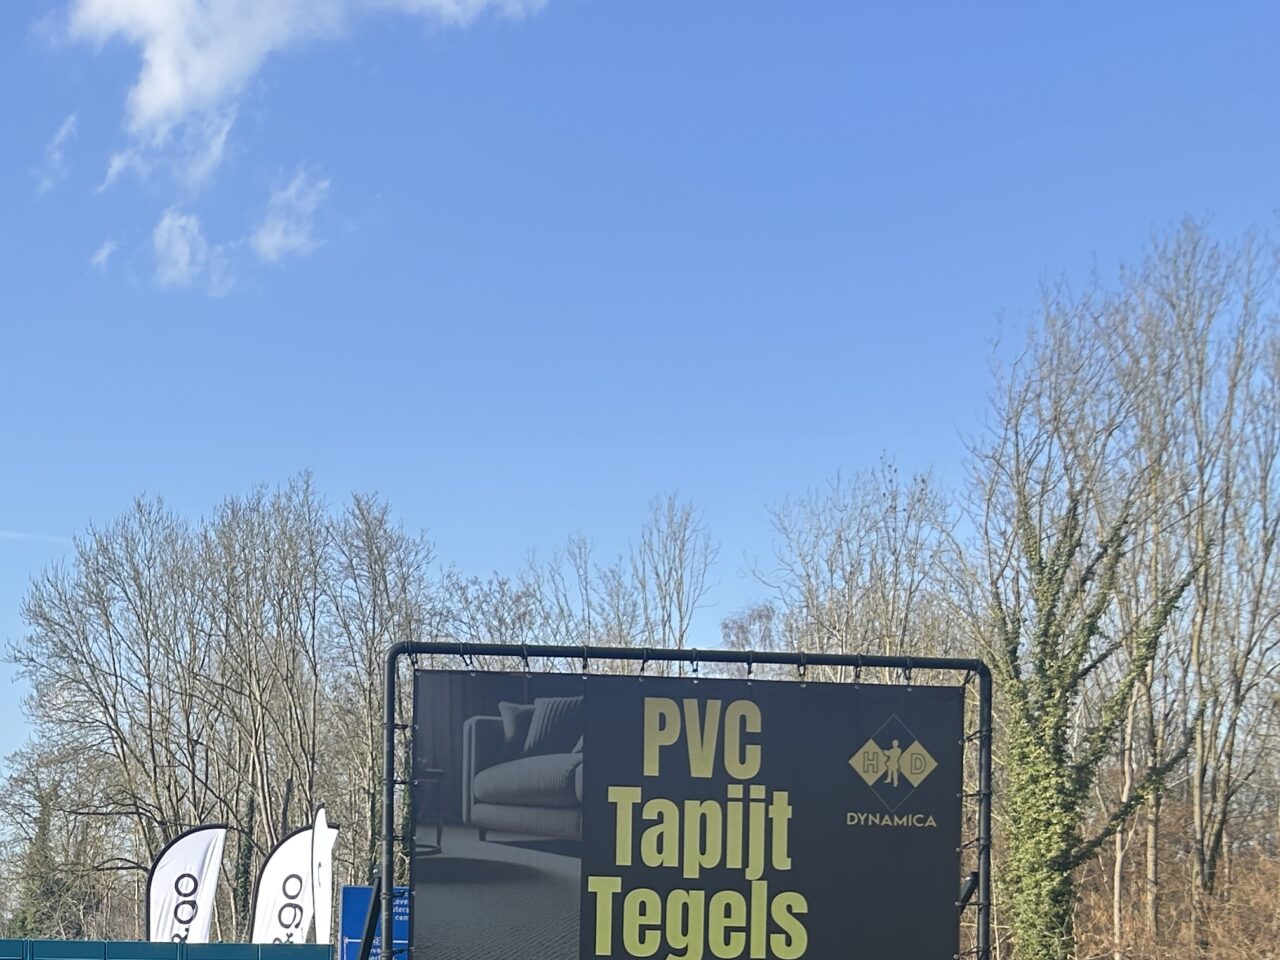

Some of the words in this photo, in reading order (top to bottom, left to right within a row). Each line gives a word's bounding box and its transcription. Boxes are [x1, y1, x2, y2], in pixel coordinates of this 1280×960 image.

[643, 696, 762, 780] PVC
[863, 751, 878, 774] H
[911, 752, 926, 774] D
[608, 784, 792, 880] Tapijt
[847, 812, 937, 827] DYNAMICA
